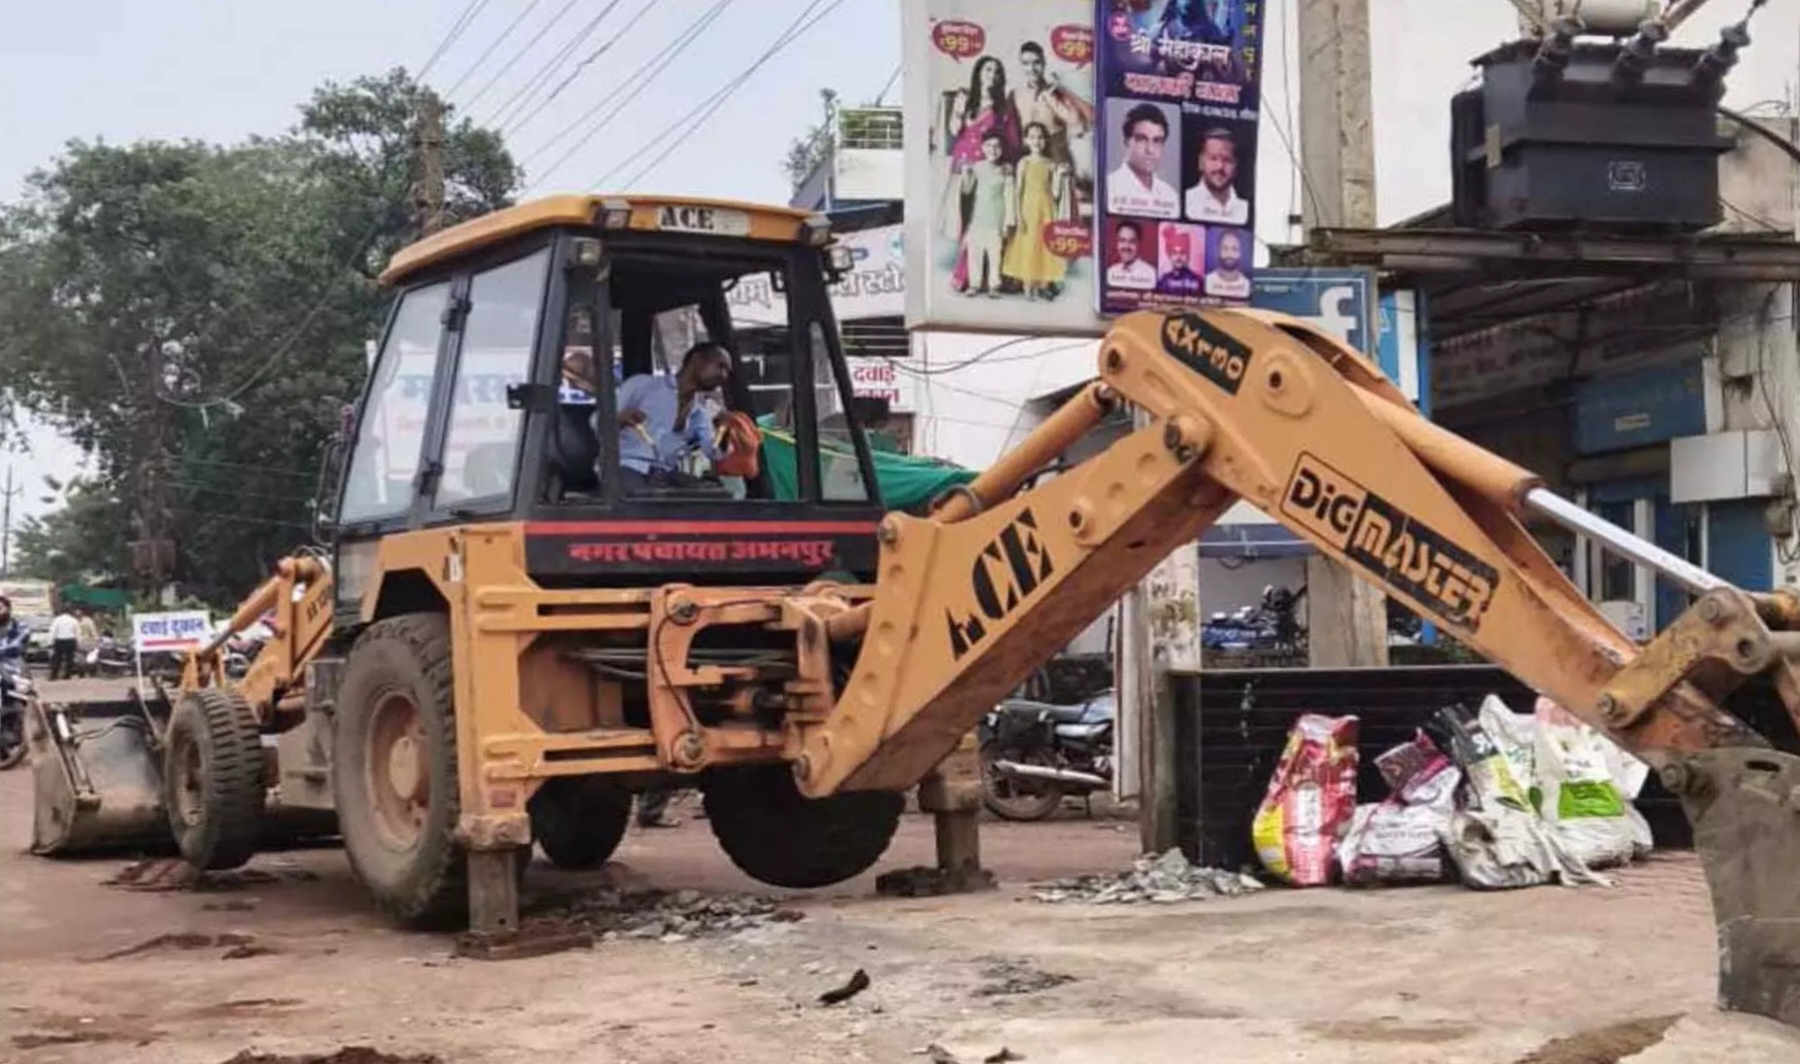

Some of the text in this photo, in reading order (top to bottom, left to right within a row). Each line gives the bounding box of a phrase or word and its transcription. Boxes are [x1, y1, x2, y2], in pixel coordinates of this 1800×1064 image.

[660, 205, 715, 230] ACE
[853, 363, 896, 386] दवाई
[567, 541, 629, 562] नगर
[632, 533, 726, 561] पंचायत
[943, 506, 1055, 664] ACE
